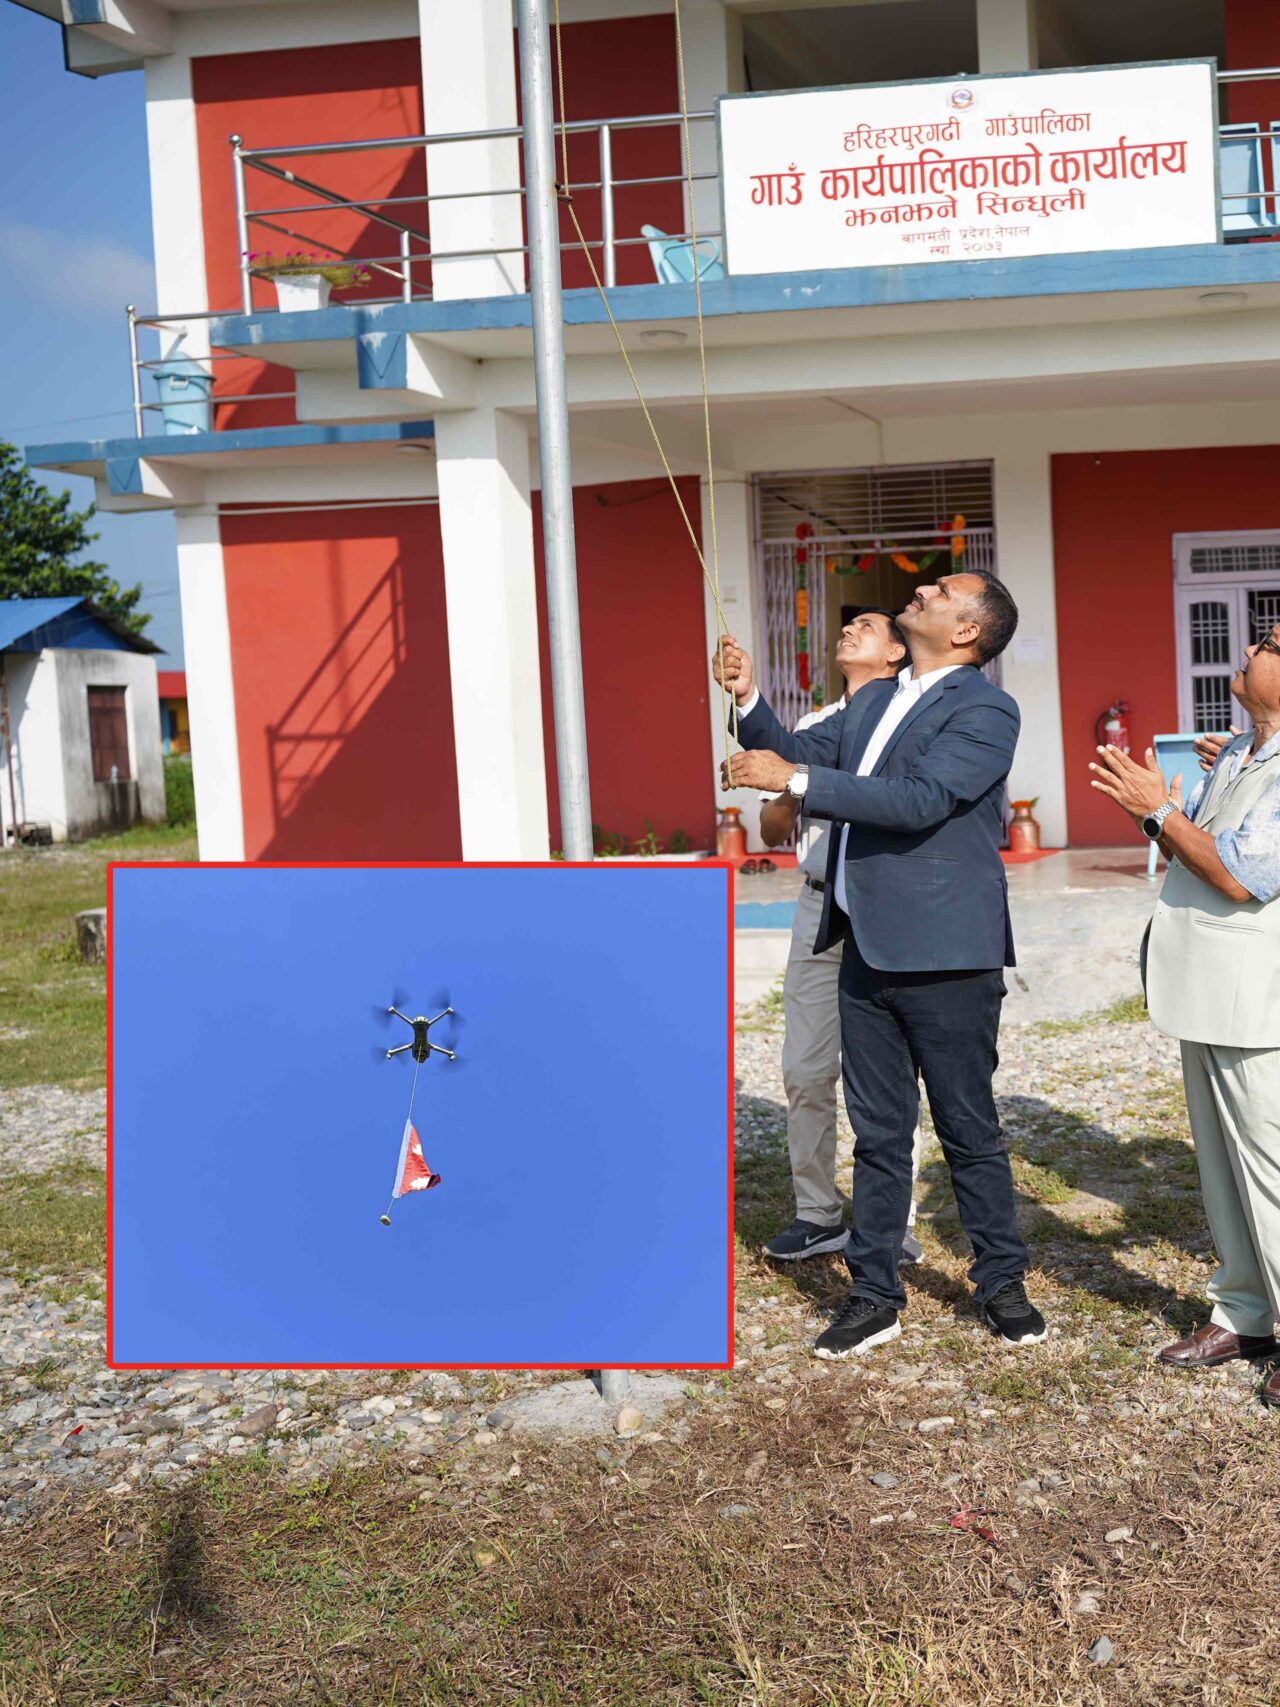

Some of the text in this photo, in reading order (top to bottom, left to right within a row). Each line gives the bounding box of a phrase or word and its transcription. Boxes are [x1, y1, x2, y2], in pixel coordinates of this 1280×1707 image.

[985, 108, 1092, 137] गाउँपालिका
[750, 135, 1189, 206] गाउँ कार्यपालिकाको कार्यालय
[976, 188, 1087, 218] सिन्धुली
[901, 227, 950, 244] बागमती
